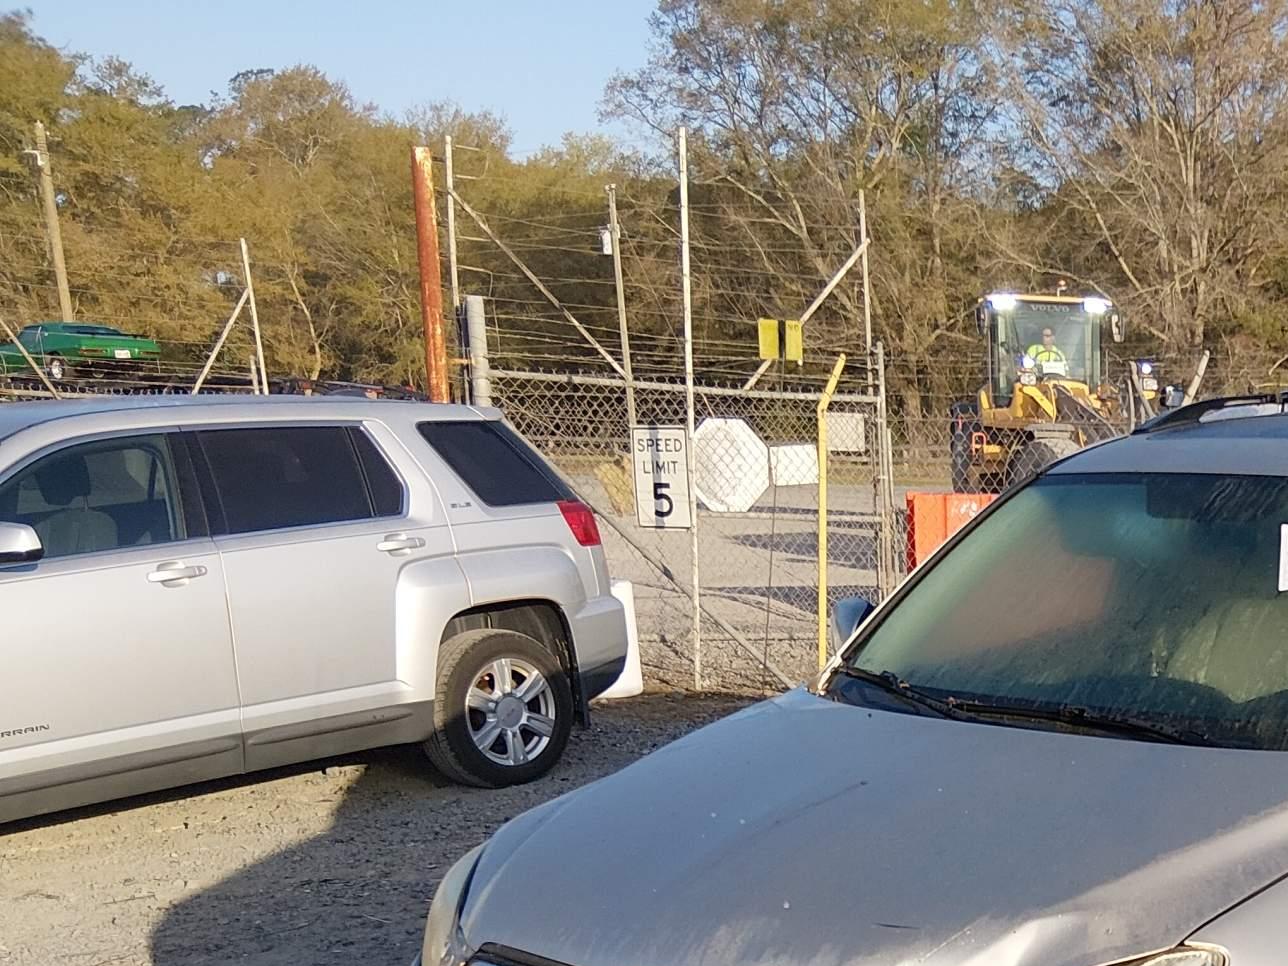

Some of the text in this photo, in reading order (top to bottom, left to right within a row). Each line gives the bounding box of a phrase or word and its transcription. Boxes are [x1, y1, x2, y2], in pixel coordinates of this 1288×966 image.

[1030, 304, 1070, 312] VOLVO
[637, 438, 682, 453] SPEED
[643, 461, 679, 474] LIMIT
[653, 482, 673, 517] 5
